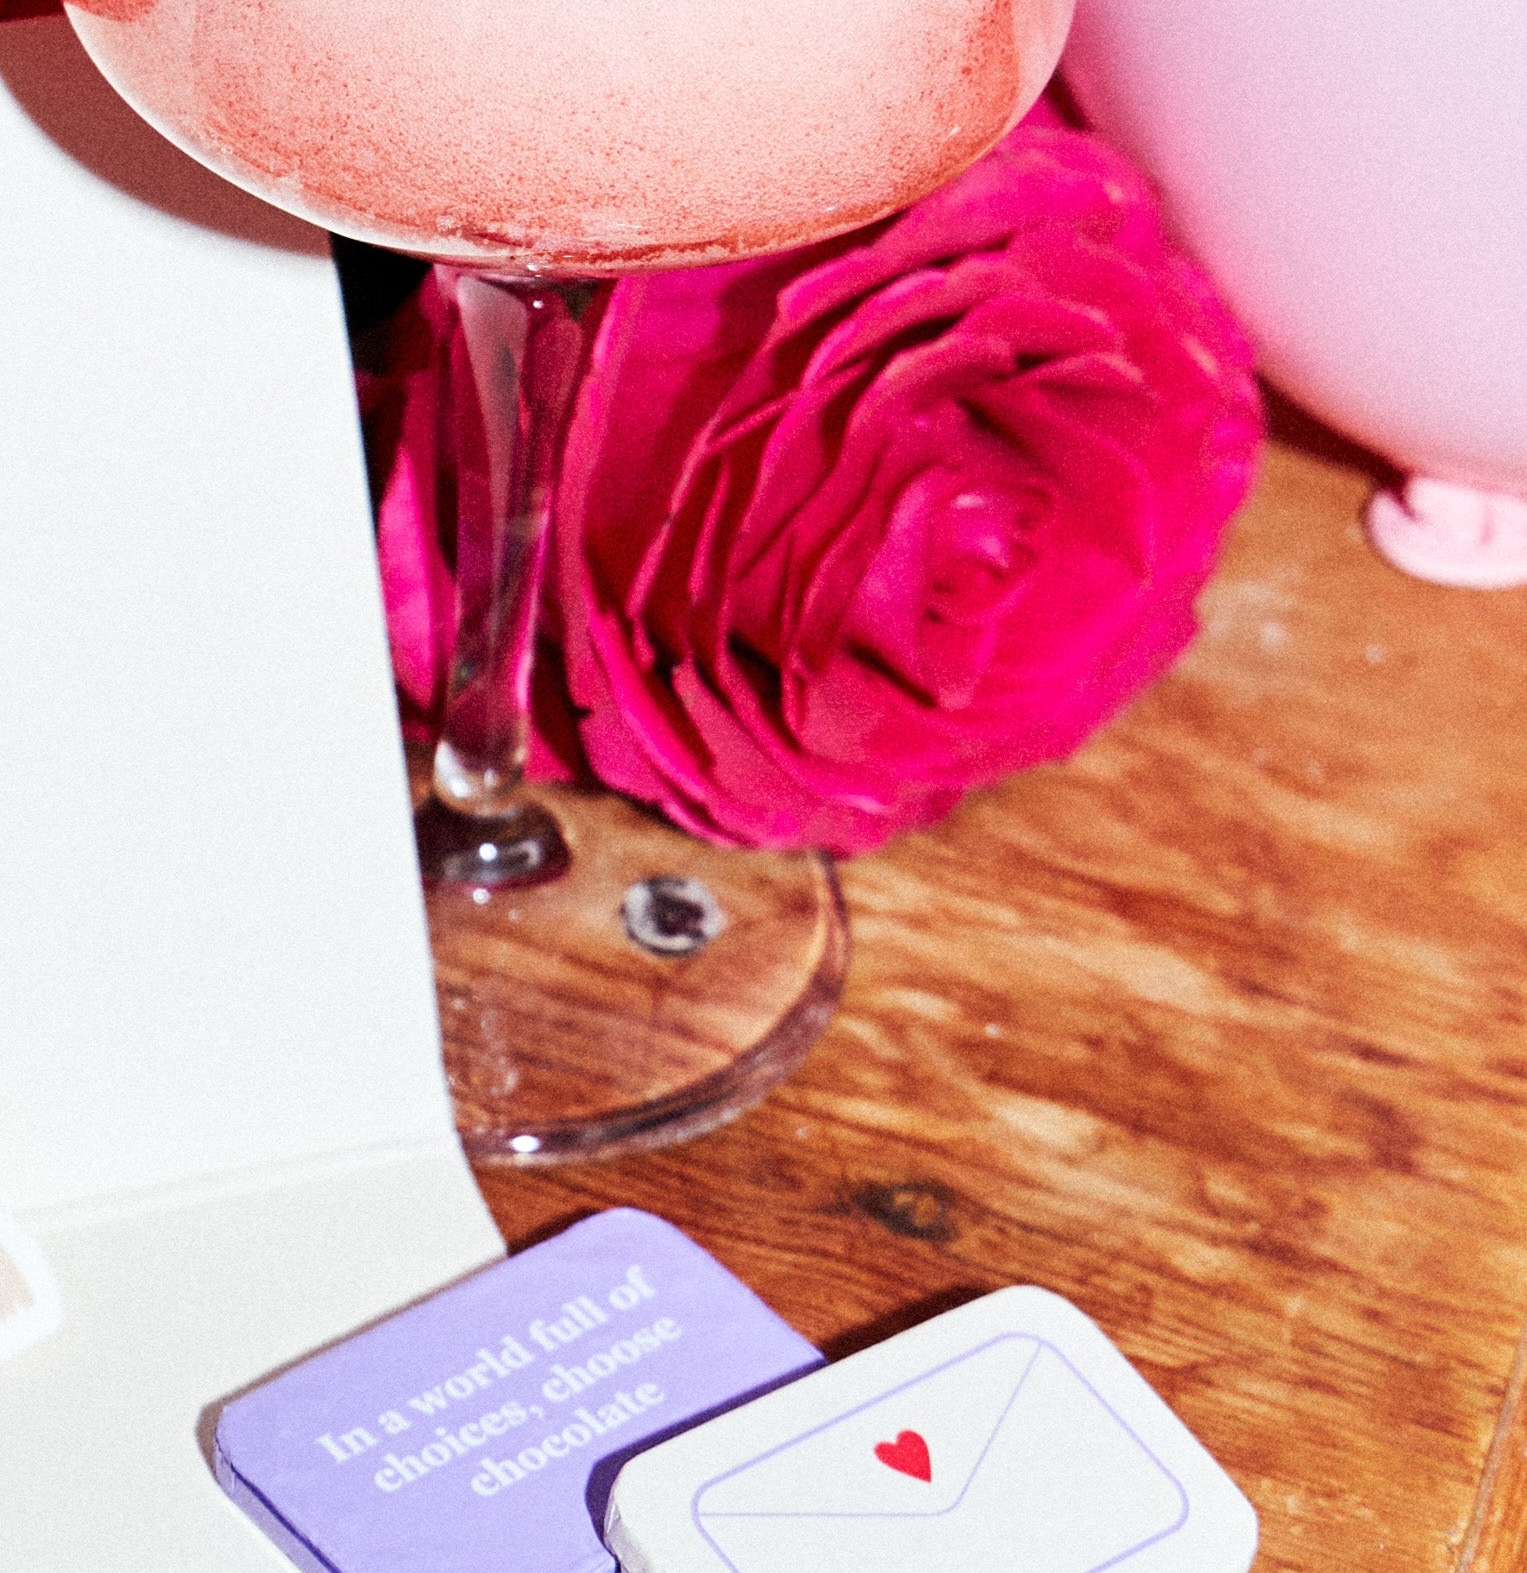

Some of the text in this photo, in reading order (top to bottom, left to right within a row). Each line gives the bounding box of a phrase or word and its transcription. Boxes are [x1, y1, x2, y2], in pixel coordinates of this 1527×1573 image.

[313, 1263, 659, 1465] In a world full of
[374, 1316, 684, 1493] choices, choose
[468, 1378, 667, 1498] chocolate
